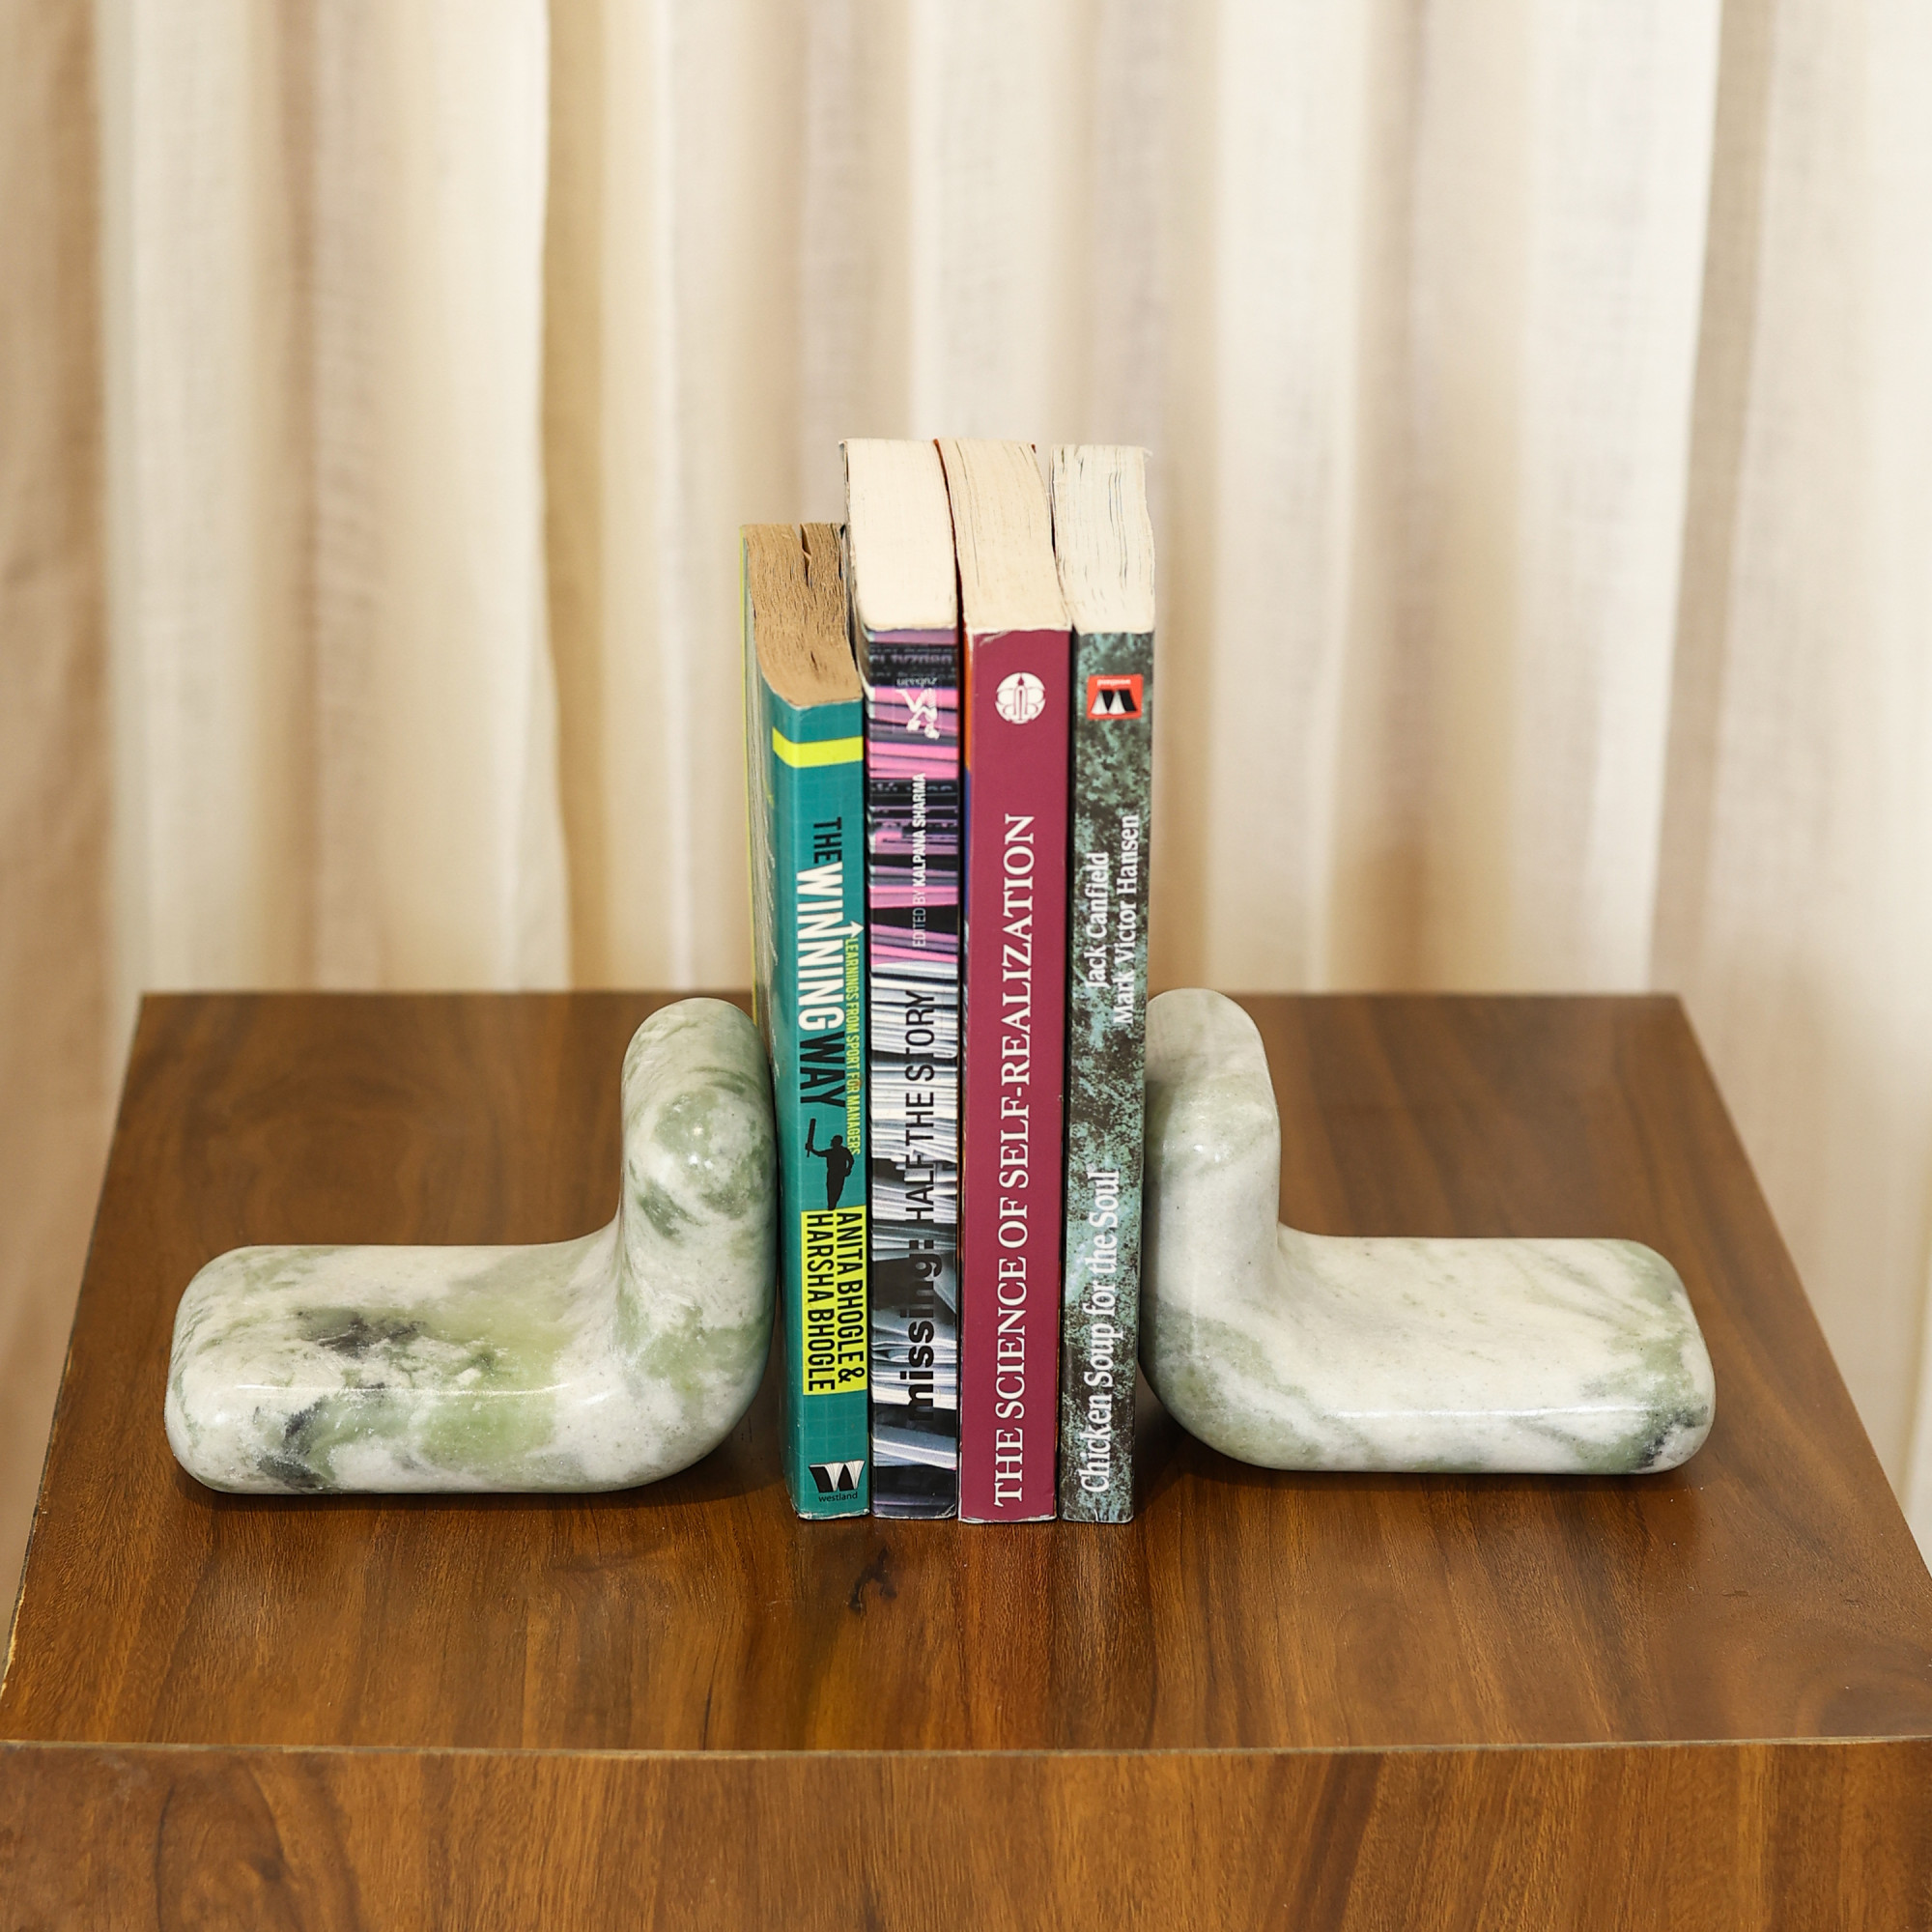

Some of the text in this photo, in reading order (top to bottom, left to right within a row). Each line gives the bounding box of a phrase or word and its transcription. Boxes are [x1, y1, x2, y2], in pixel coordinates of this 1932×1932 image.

[912, 773, 926, 948] EDITED BY KALPANA SHARMA
[1084, 851, 1111, 989] Jack Canfield
[1111, 814, 1139, 1025] Mark Victor Hansen
[796, 816, 846, 1107] THE WINNING WAY
[845, 937, 861, 1155] LEARNINGS FROM SPORT FOR MANAGERS
[905, 990, 935, 1082] STORY
[905, 1092, 934, 1147] THE
[905, 1154, 935, 1222] HALF
[993, 813, 1036, 1507] THE SCIENCE OF SELF-REALIZATION
[807, 1212, 836, 1392] HARSHA BHOGLE
[836, 1212, 866, 1384] ANITA BHOGLE &
[1076, 1170, 1123, 1493] Chicken Soup for the Soul
[818, 1491, 859, 1503] westland
